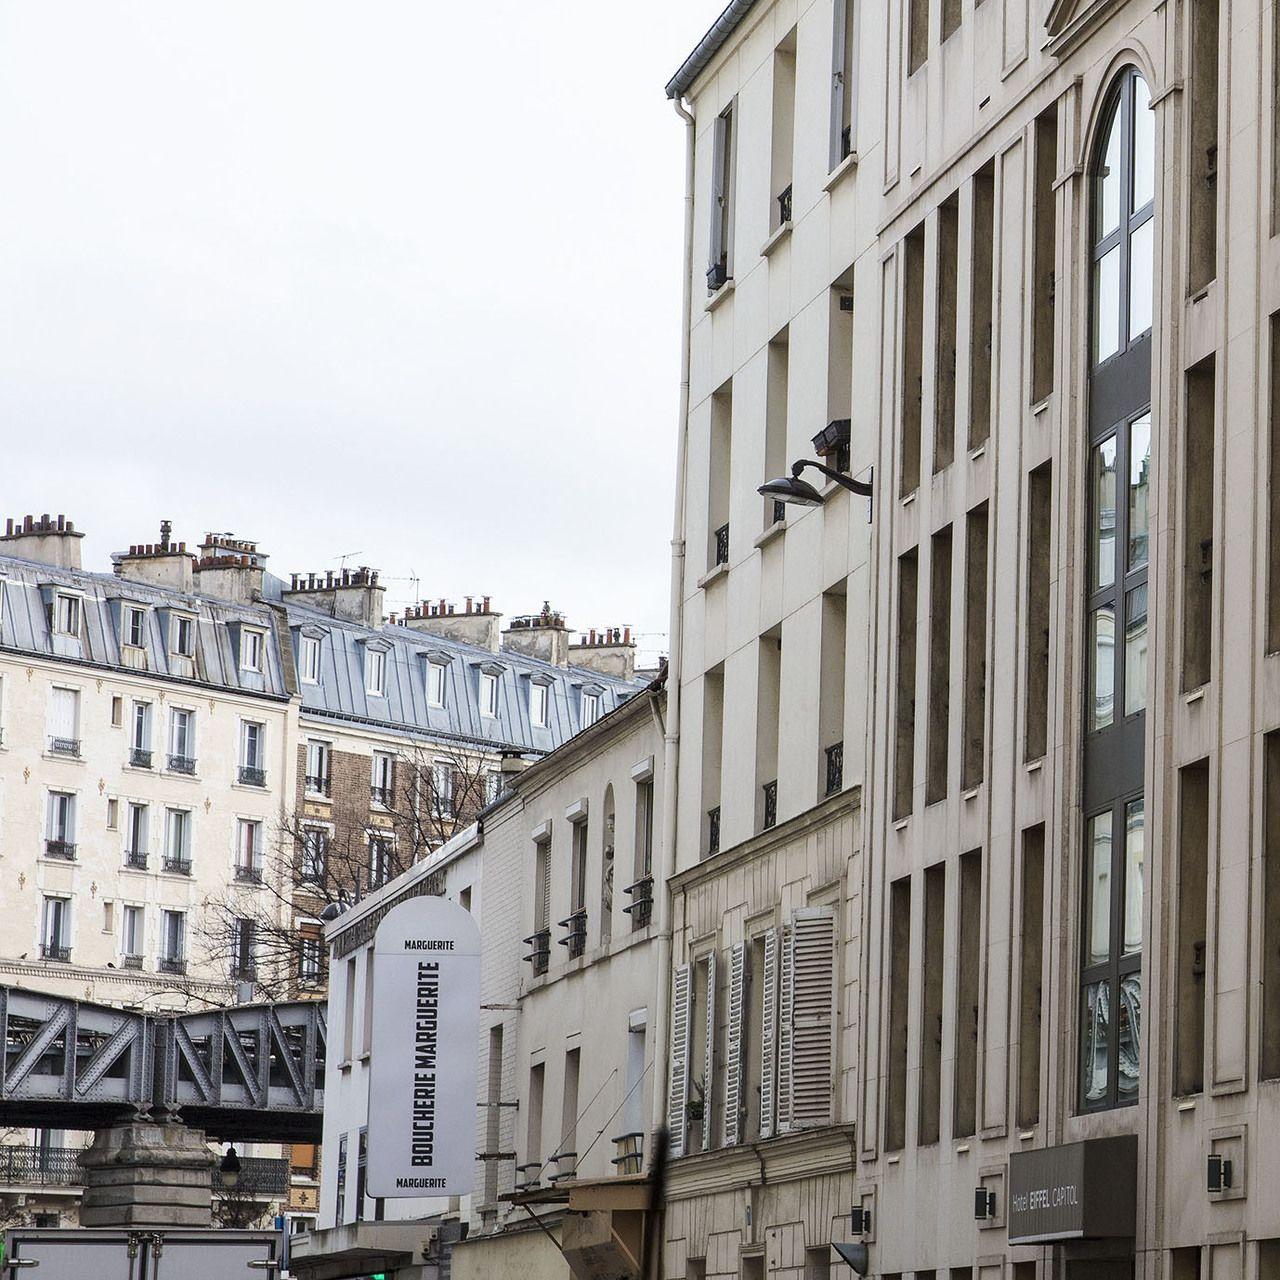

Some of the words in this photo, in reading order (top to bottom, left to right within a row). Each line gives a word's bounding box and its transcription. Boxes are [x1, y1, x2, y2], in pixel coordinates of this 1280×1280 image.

[404, 940, 455, 951] MARGUERITE
[415, 961, 440, 1069] MARGUERITE
[411, 1072, 436, 1167] BOUCHERIE
[396, 1178, 447, 1189] MARGUERITE
[1012, 1192, 1028, 1213] Hotel
[1030, 1189, 1050, 1210] EIFFEL
[1053, 1185, 1079, 1207] CAPITOL
